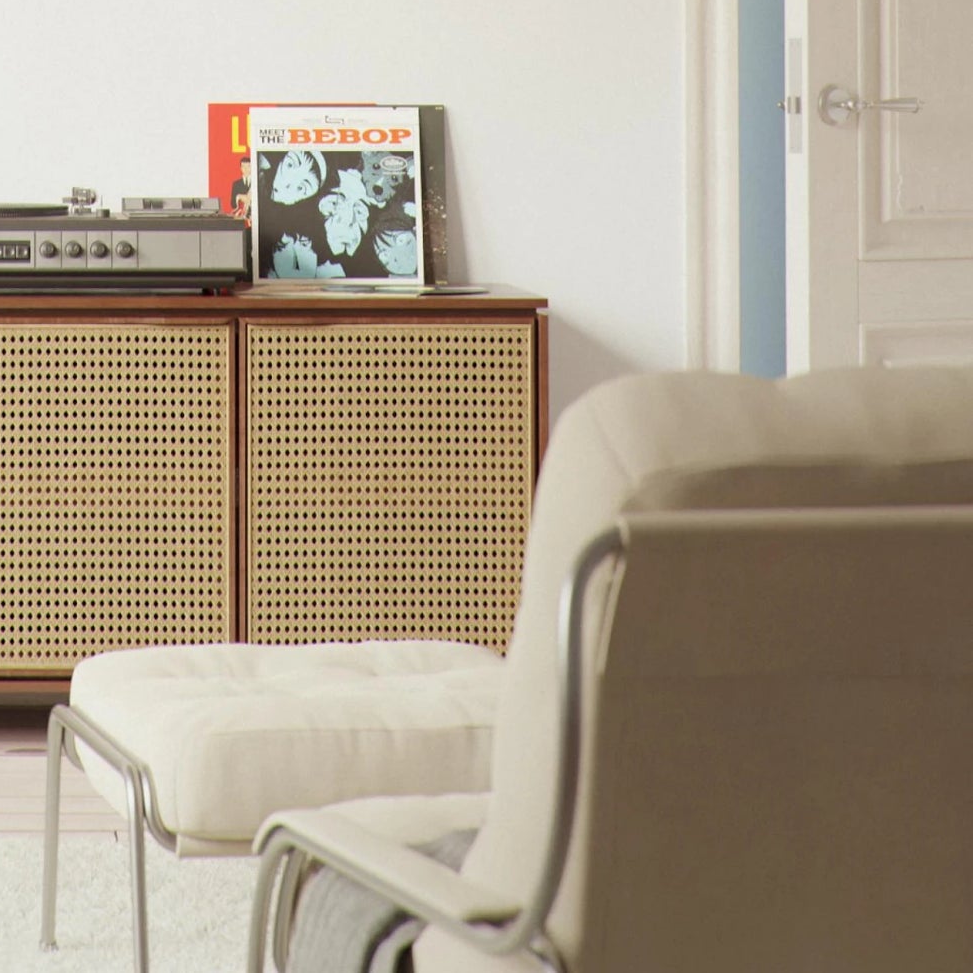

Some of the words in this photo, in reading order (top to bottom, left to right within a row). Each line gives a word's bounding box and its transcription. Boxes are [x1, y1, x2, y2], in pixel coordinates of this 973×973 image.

[231, 114, 251, 153] L
[260, 136, 285, 144] THE
[287, 128, 412, 144] BEBOP
